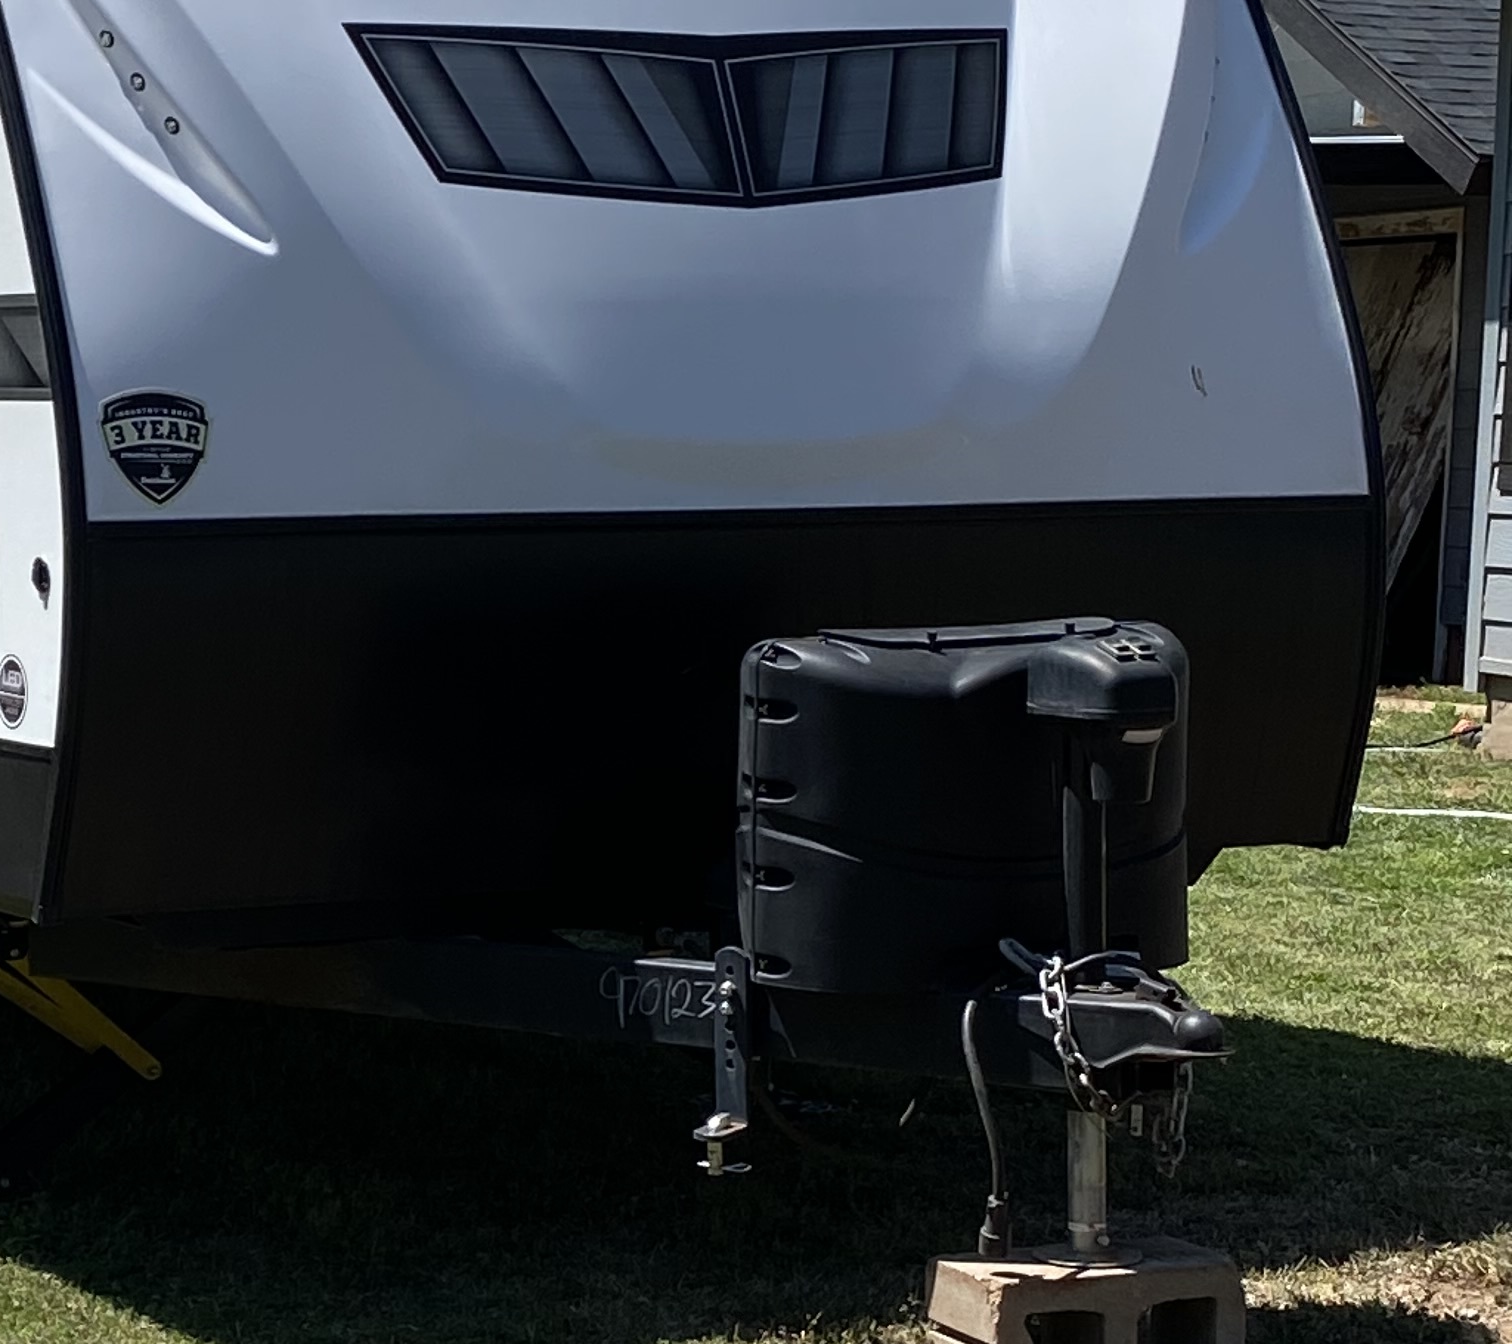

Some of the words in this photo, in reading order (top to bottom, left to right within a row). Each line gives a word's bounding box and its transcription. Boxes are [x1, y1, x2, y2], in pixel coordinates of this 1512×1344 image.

[109, 424, 127, 446] 3
[130, 419, 201, 445] YEAR
[2, 667, 23, 688] LED
